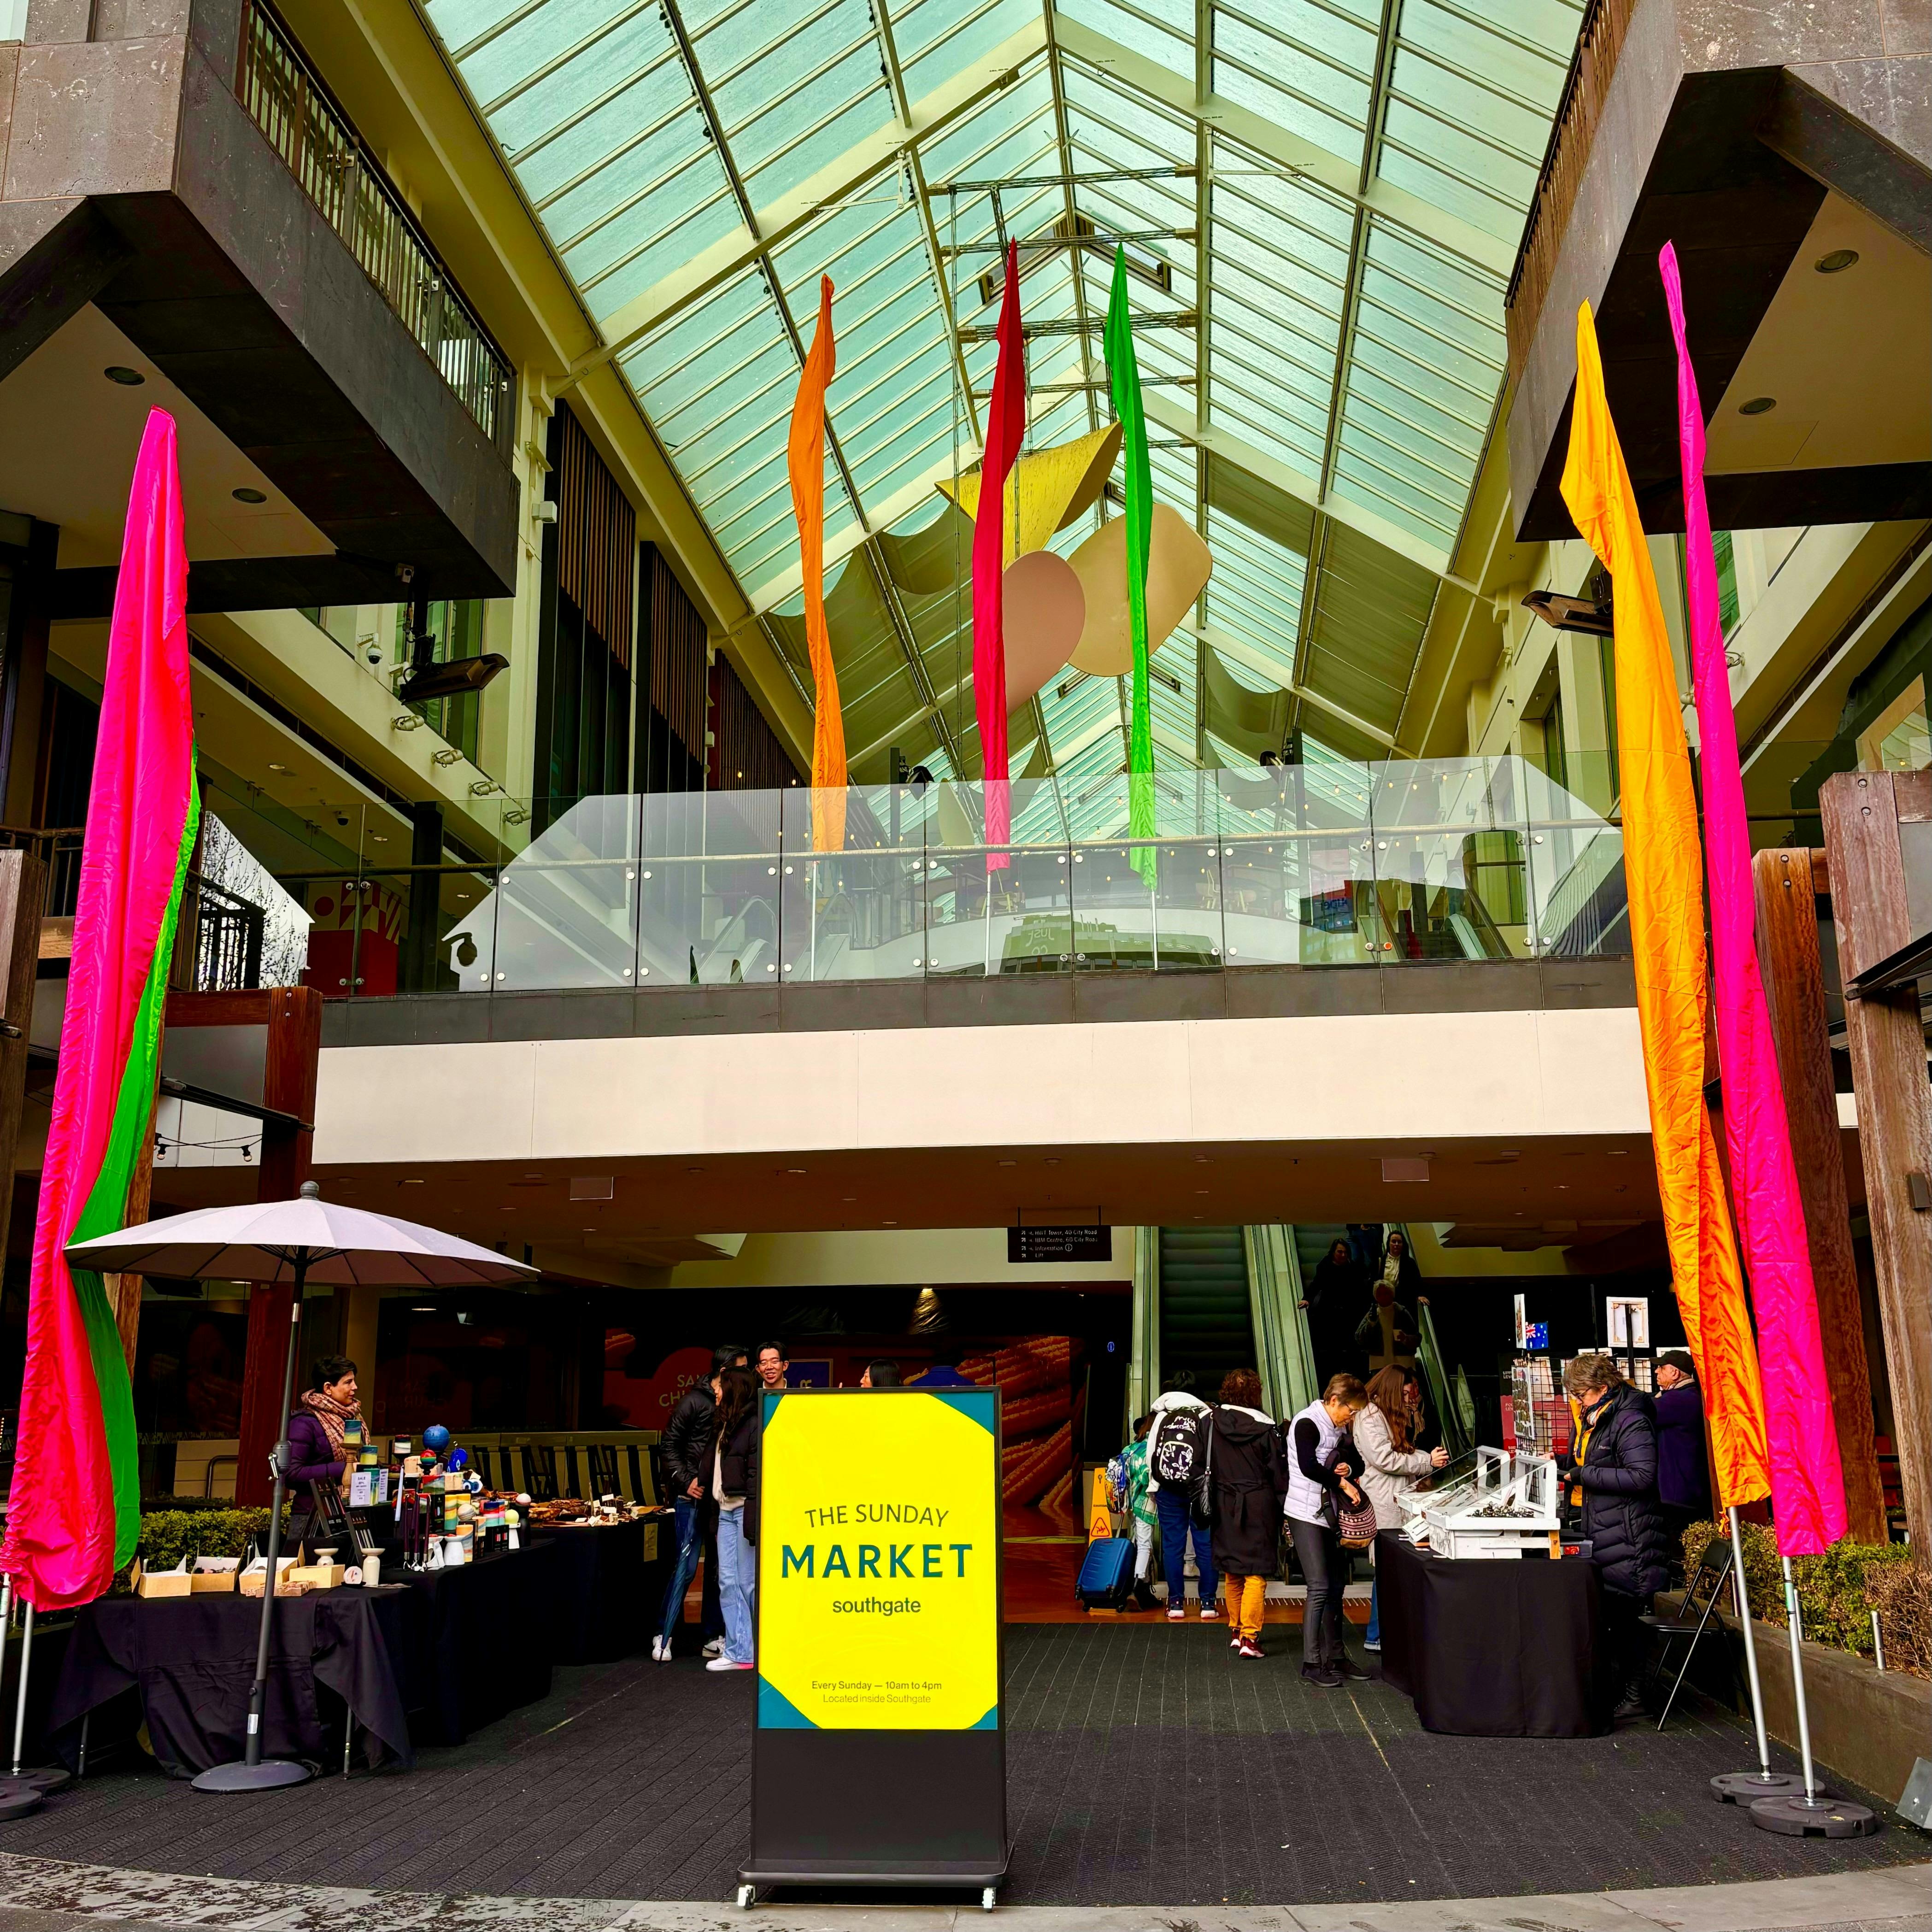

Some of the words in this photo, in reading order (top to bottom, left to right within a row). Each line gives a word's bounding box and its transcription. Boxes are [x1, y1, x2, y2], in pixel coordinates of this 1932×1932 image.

[805, 1505, 848, 1528] THE
[855, 1503, 949, 1527] SUNDAY
[781, 1544, 973, 1579] MARKET
[833, 1596, 921, 1616] southgate
[812, 1681, 837, 1691] Every
[839, 1681, 872, 1691] Sunday
[886, 1681, 909, 1689] 10am
[911, 1681, 920, 1690] to
[922, 1681, 942, 1691] 4pm
[823, 1694, 858, 1703] Located
[860, 1694, 885, 1703] inside
[887, 1694, 931, 1704] Southgate
